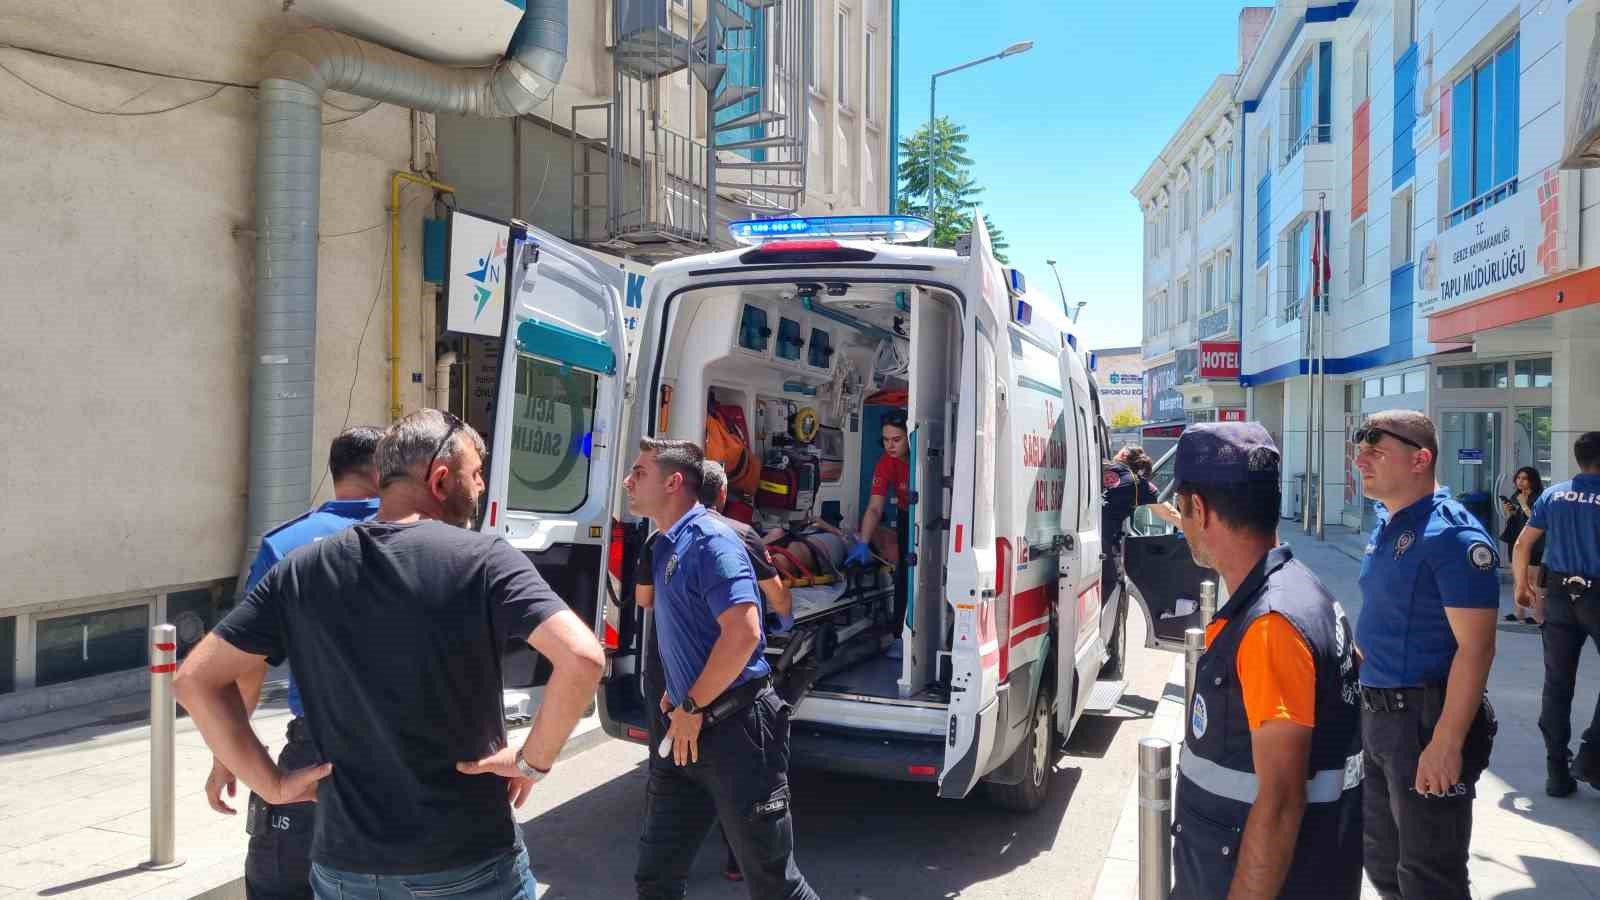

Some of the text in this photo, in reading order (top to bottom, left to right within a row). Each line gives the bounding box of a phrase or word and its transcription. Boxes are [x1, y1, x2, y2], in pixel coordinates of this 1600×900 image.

[626, 272, 647, 309] K
[1441, 244, 1526, 300] TAPU MÜDÜRLÜĞÜ
[1202, 351, 1239, 369] HOTEL
